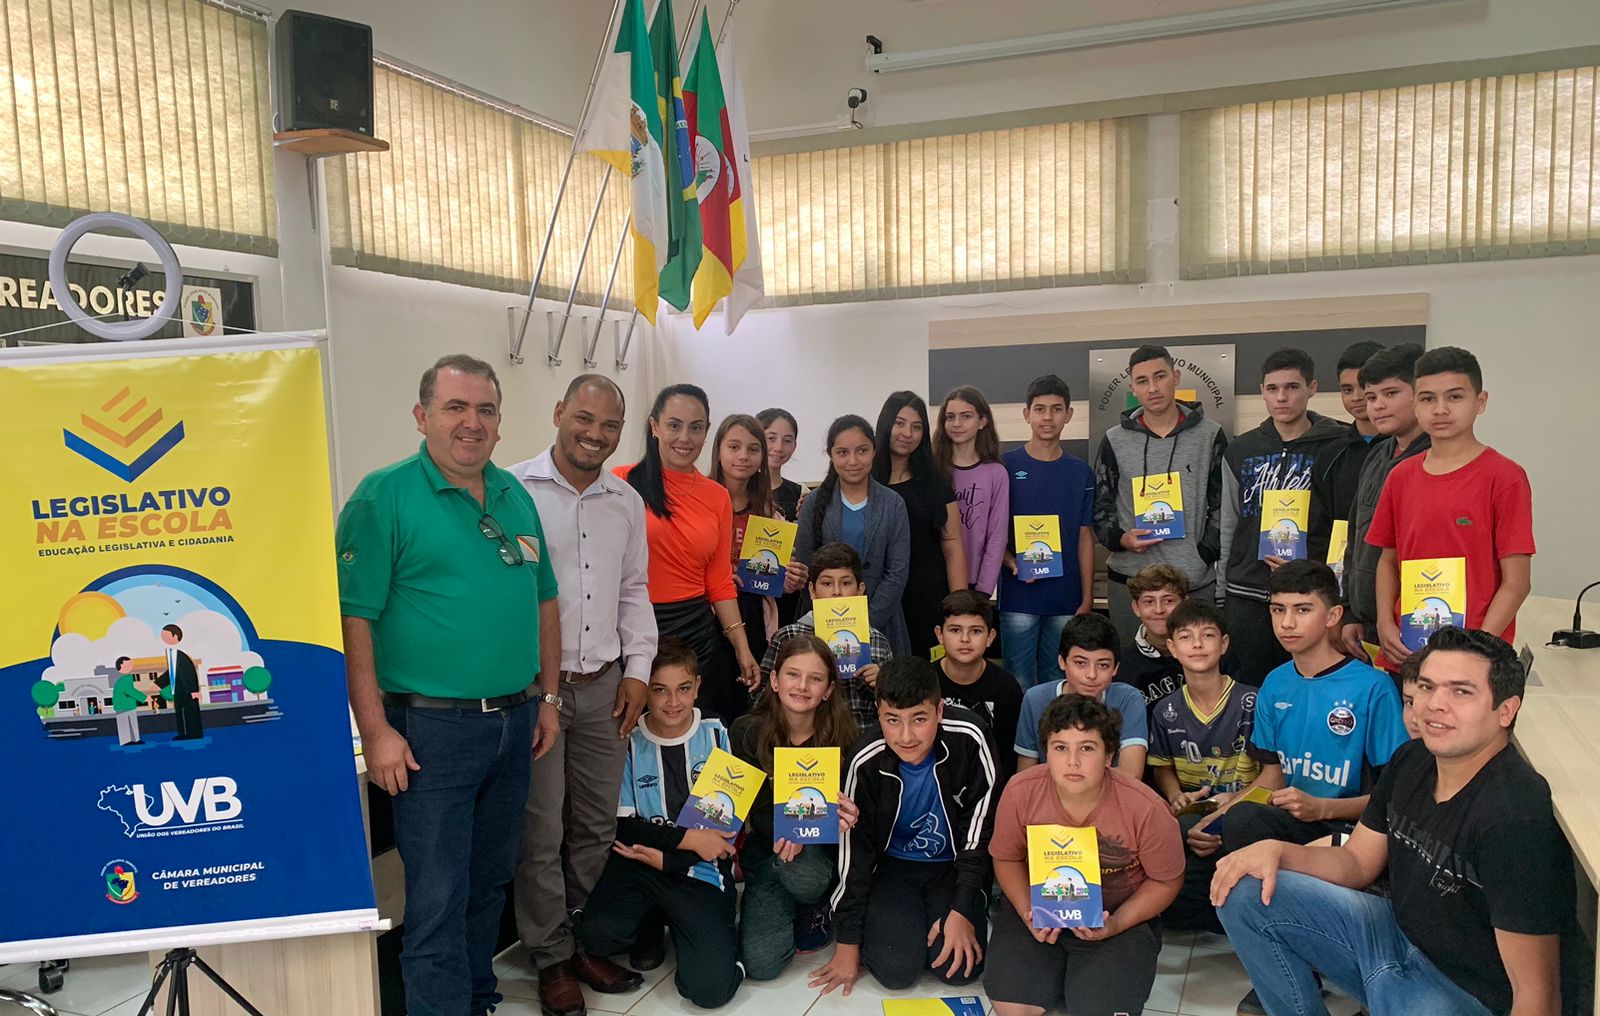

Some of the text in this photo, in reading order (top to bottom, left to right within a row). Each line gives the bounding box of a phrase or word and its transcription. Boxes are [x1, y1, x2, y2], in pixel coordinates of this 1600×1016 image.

[1099, 378, 1121, 411] PODER
[1187, 363, 1225, 409] MUNICIPAL
[32, 487, 231, 519] LEGISLATIVO
[36, 509, 233, 544] NA ESCOLA
[38, 545, 96, 557] EDUCAÇÃO
[98, 541, 166, 552] LEGISLATIVA
[178, 535, 235, 546] CIDADANIA
[1277, 548, 1293, 556] UVB
[1035, 567, 1050, 575] UVB
[754, 581, 770, 590] UVB
[839, 664, 857, 673] UVB
[132, 776, 243, 826] UVB
[136, 831, 156, 839] UNIÃO
[170, 827, 211, 836] VEREADORES
[222, 823, 245, 831] BRASIL
[799, 827, 821, 837] UVB
[152, 861, 265, 880] CÂMARA MUNICIPAL
[163, 873, 256, 890] DE VEREADORES
[1059, 909, 1082, 919] UVB
